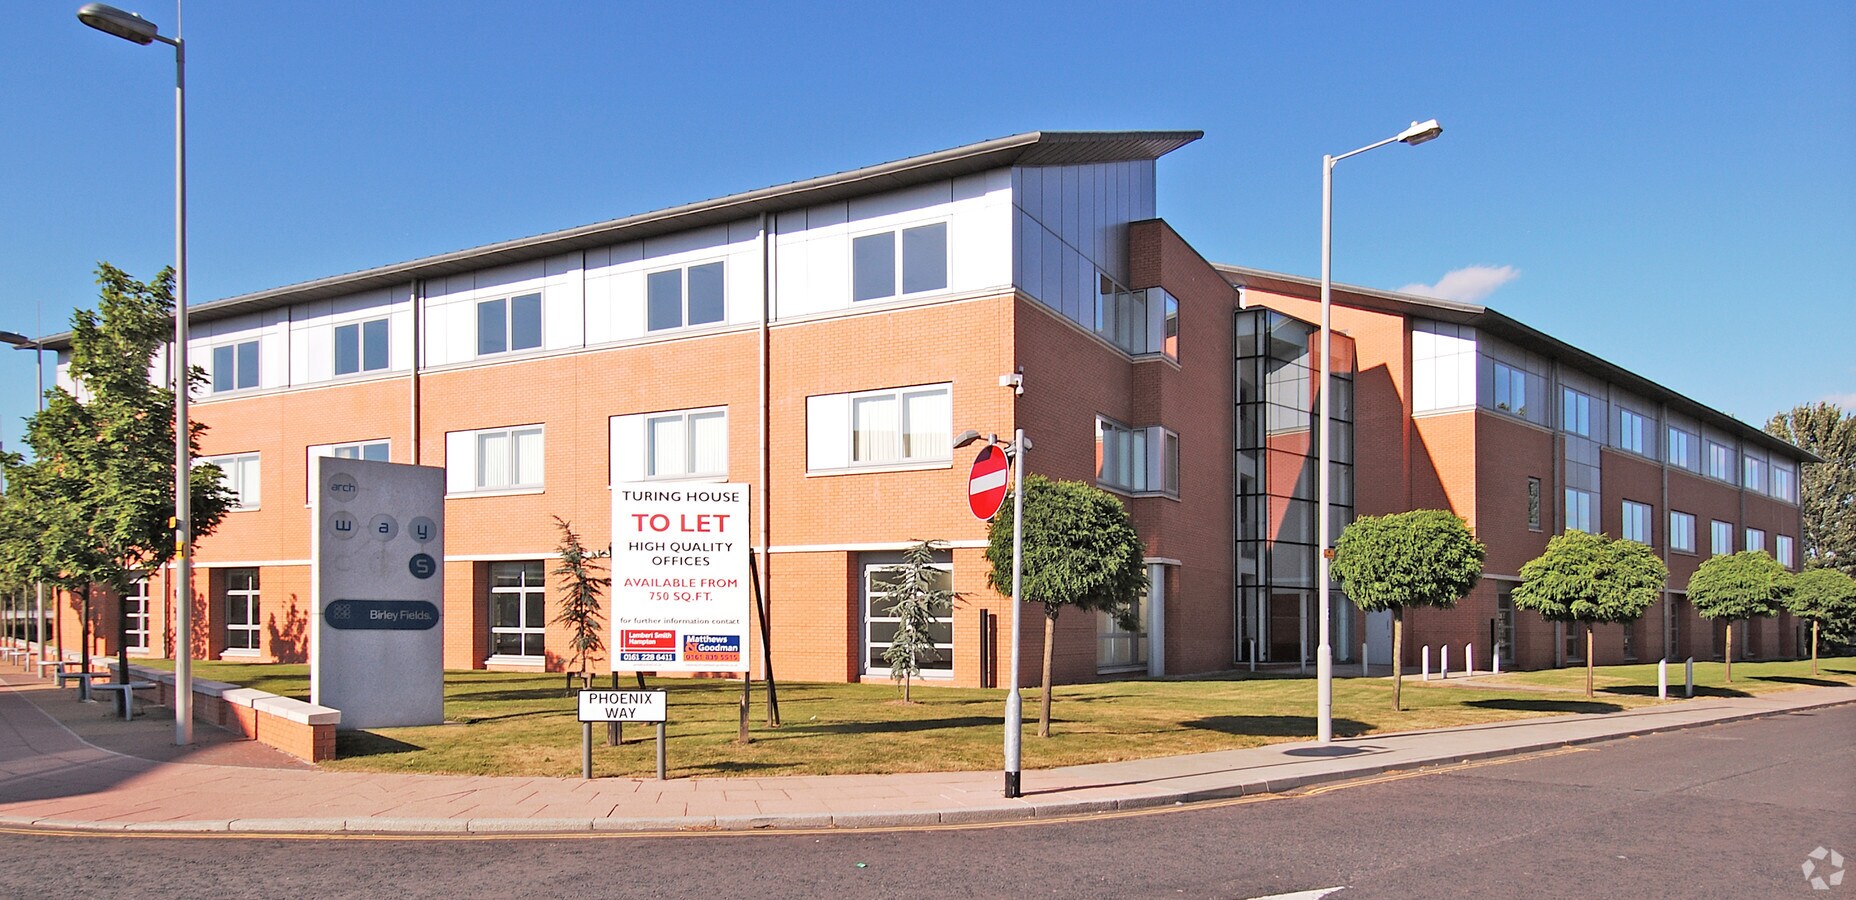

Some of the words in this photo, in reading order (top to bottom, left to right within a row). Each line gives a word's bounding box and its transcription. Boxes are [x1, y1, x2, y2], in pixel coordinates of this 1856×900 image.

[331, 482, 356, 493] arch
[622, 490, 681, 502] TURING
[686, 491, 740, 503] HOUSE
[632, 514, 670, 532] TO
[680, 514, 730, 533] LET
[629, 542, 665, 552] HIGH
[670, 542, 733, 553] QUALITY
[652, 556, 710, 566] OFFICES
[624, 578, 696, 588] AVAILABLE
[700, 579, 738, 588] FROM
[649, 591, 669, 601] 750
[673, 592, 713, 602] SQ.FT.
[369, 610, 398, 621] Birley
[620, 616, 632, 624] for
[686, 635, 728, 643] Matthews
[698, 644, 739, 652] Goodman
[623, 653, 640, 661] 0161
[589, 693, 653, 704] PHOENIX
[605, 707, 636, 718] WAY
